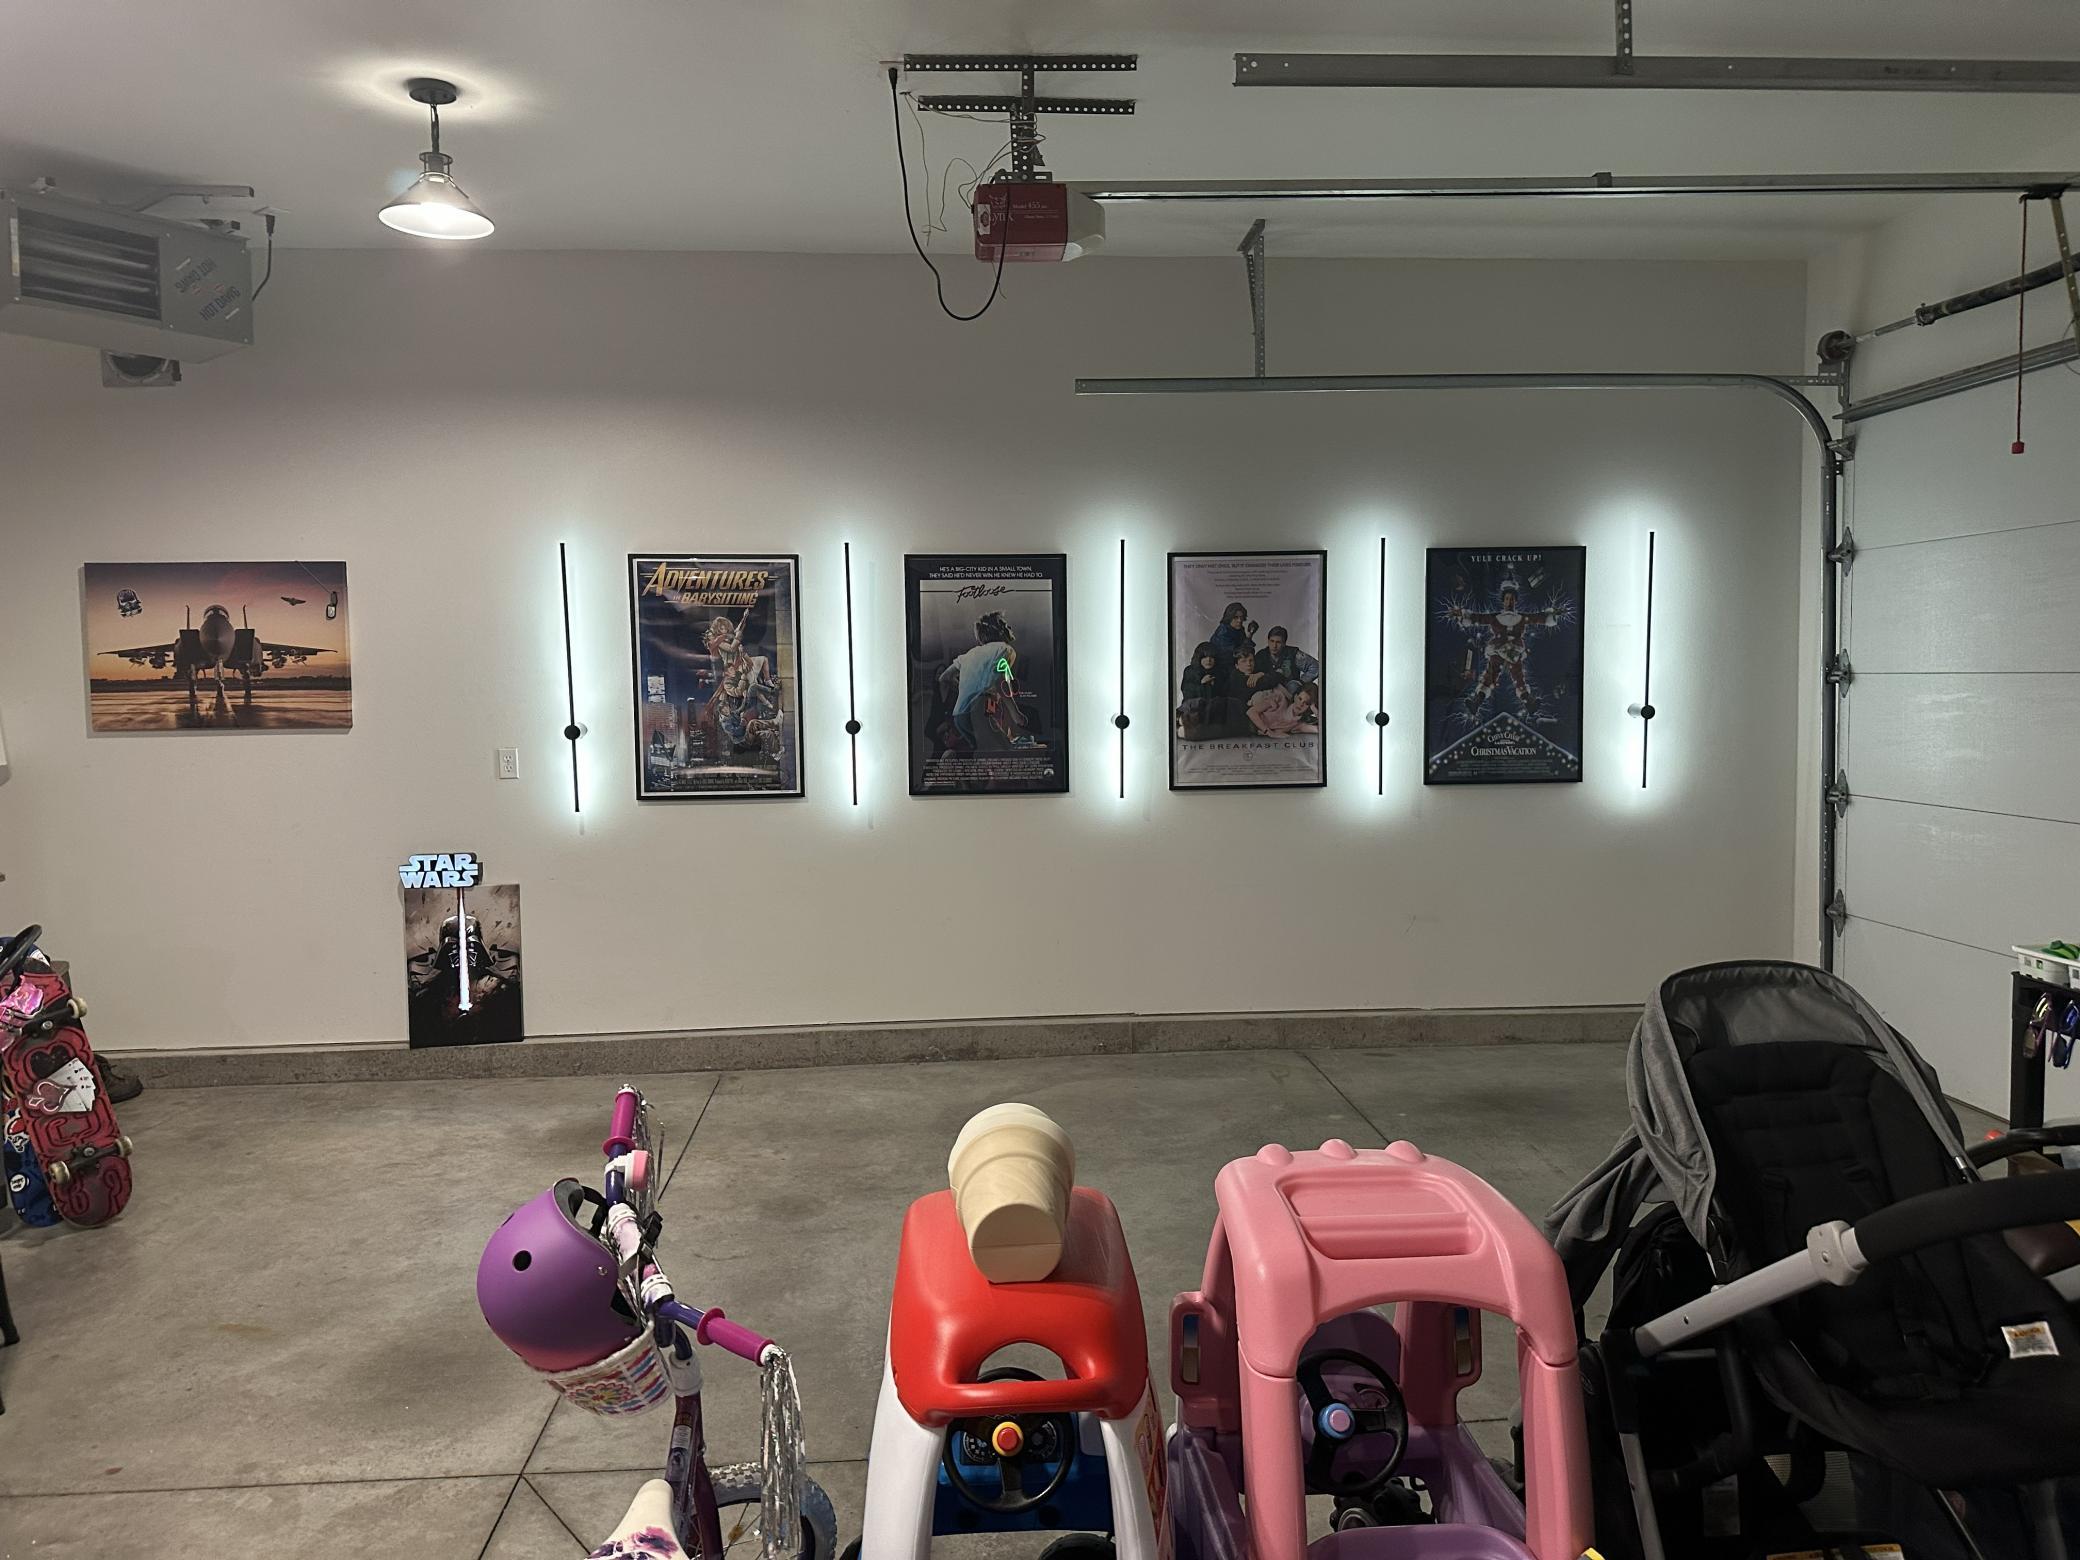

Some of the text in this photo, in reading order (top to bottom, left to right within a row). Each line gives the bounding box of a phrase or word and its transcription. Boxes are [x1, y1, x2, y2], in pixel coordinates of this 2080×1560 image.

[199, 301, 219, 321] HOT
[1495, 554, 1523, 562] CRACK
[1527, 554, 1542, 562] UP!
[641, 561, 769, 597] ADVENTURES
[681, 590, 759, 605] BABYSITTING
[955, 584, 1014, 604] Footloose
[1182, 741, 1315, 751] THE BREAKFAST CLUB
[1470, 745, 1537, 757] CHRISTMAS VACATION
[398, 853, 479, 872] STAR
[399, 870, 479, 889] WARS
